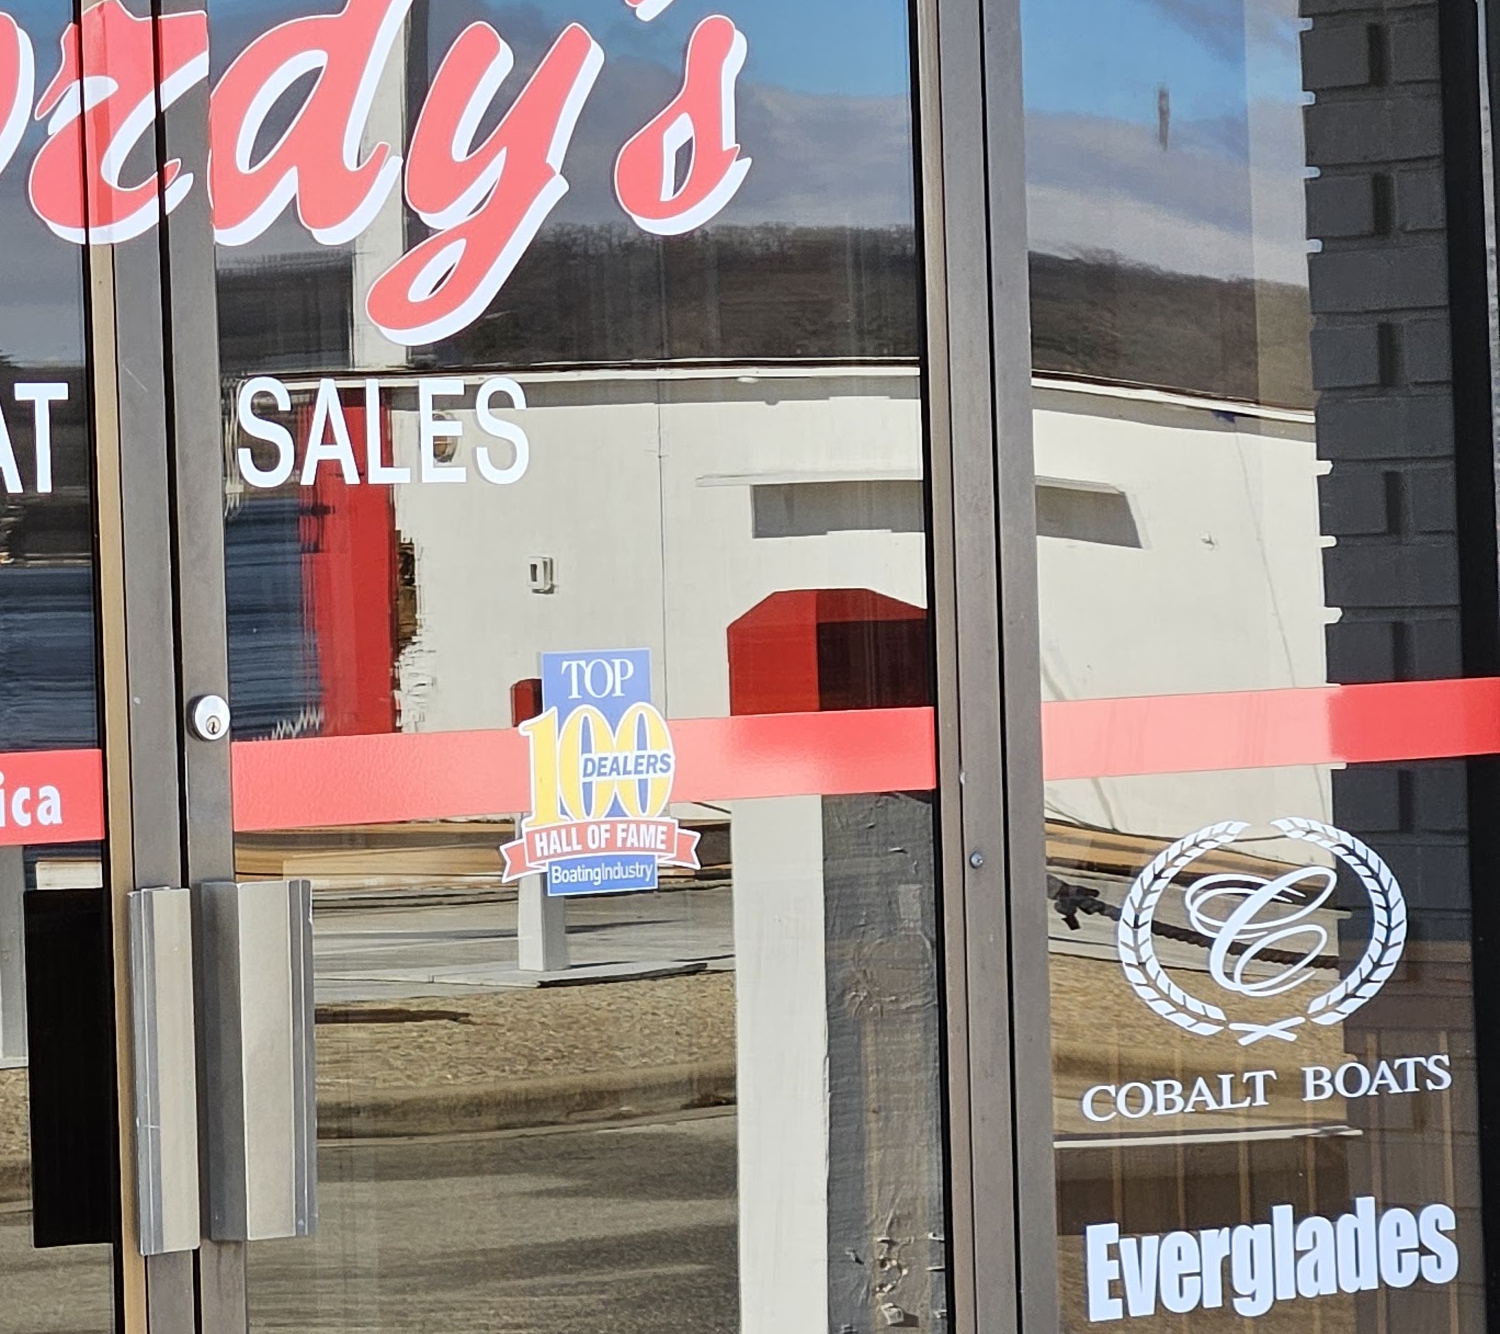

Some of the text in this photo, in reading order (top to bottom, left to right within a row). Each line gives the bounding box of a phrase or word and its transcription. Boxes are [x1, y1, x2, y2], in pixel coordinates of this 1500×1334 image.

[236, 375, 532, 489] SALES
[560, 658, 635, 700] TOP
[518, 701, 675, 827] 100
[583, 754, 671, 778] DEALERS
[534, 823, 667, 858] HALL OF FAME
[1081, 1053, 1453, 1122] COBALT BOATS
[1085, 1195, 1460, 1323] Everglades
